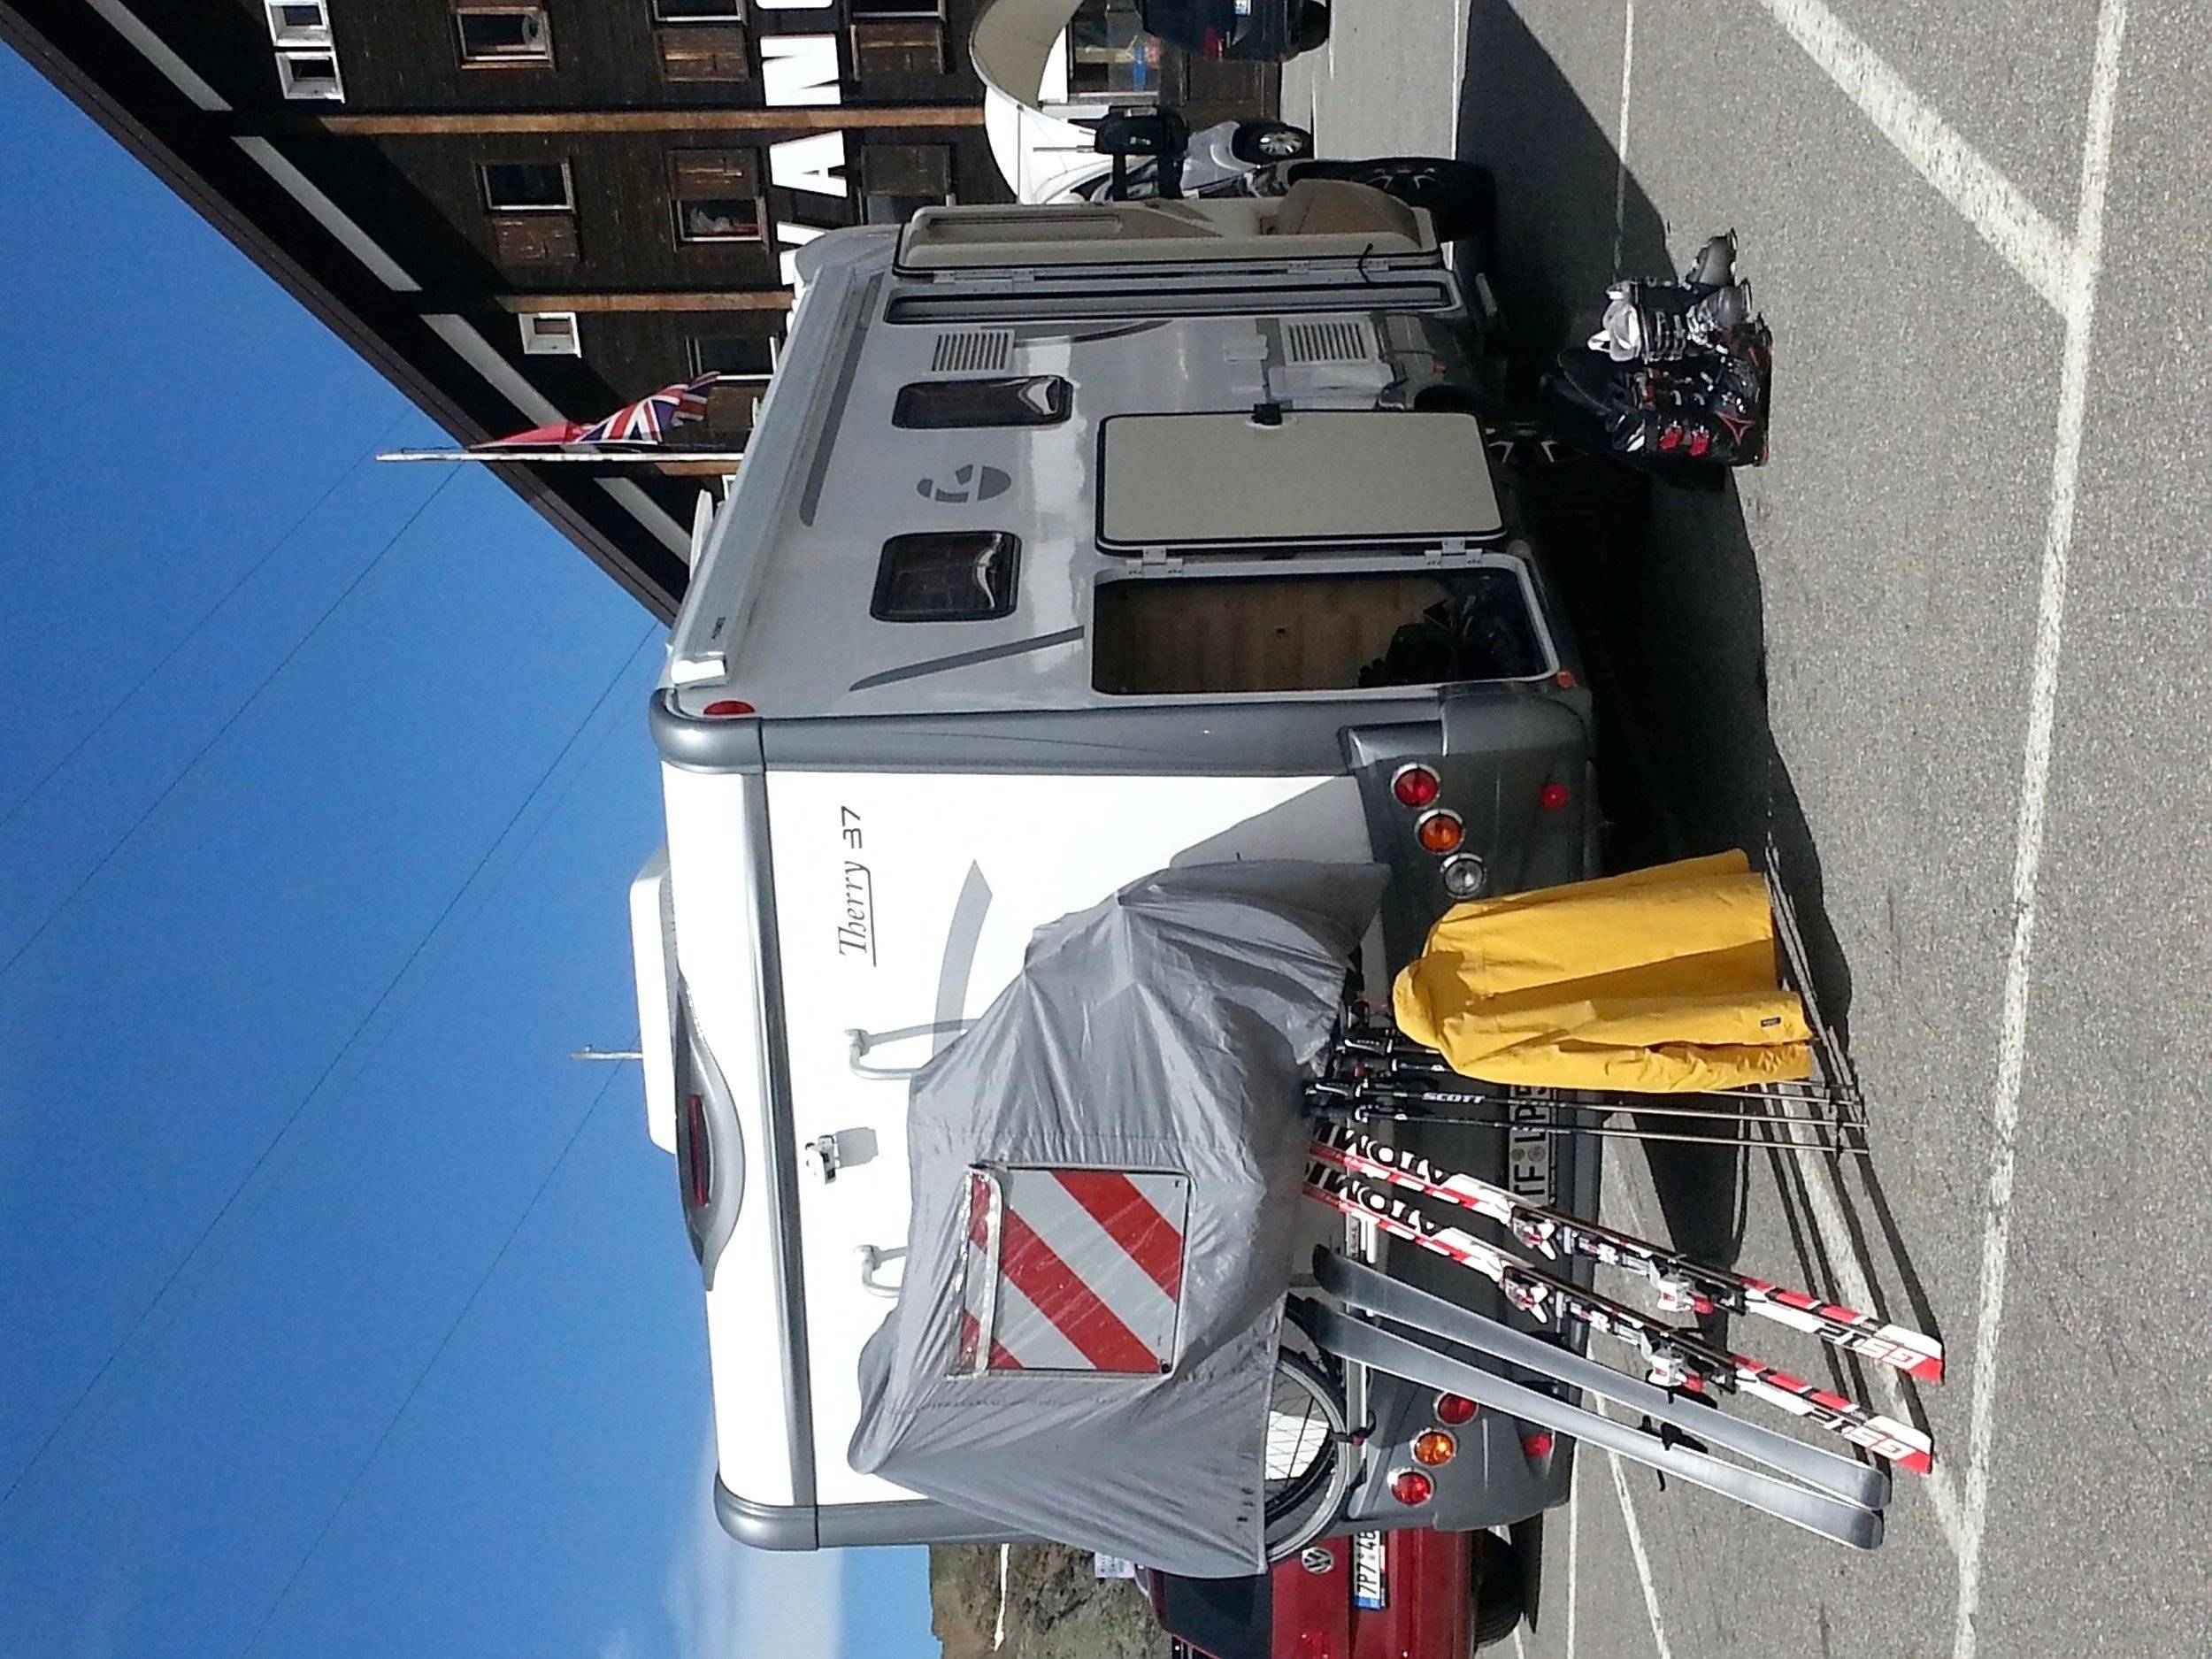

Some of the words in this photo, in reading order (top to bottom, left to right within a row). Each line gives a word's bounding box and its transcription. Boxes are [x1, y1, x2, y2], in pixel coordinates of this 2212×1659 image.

[757, 0, 848, 286] VAN
[841, 805, 863, 849] 37
[837, 861, 876, 966] Therry
[1422, 1093, 1486, 1103] SCOTT
[1312, 1118, 1455, 1187] ATOMI
[1514, 1164, 1546, 1196] TF
[1304, 1162, 1449, 1238] ATOMI
[1356, 1562, 1377, 1595] 7P7
